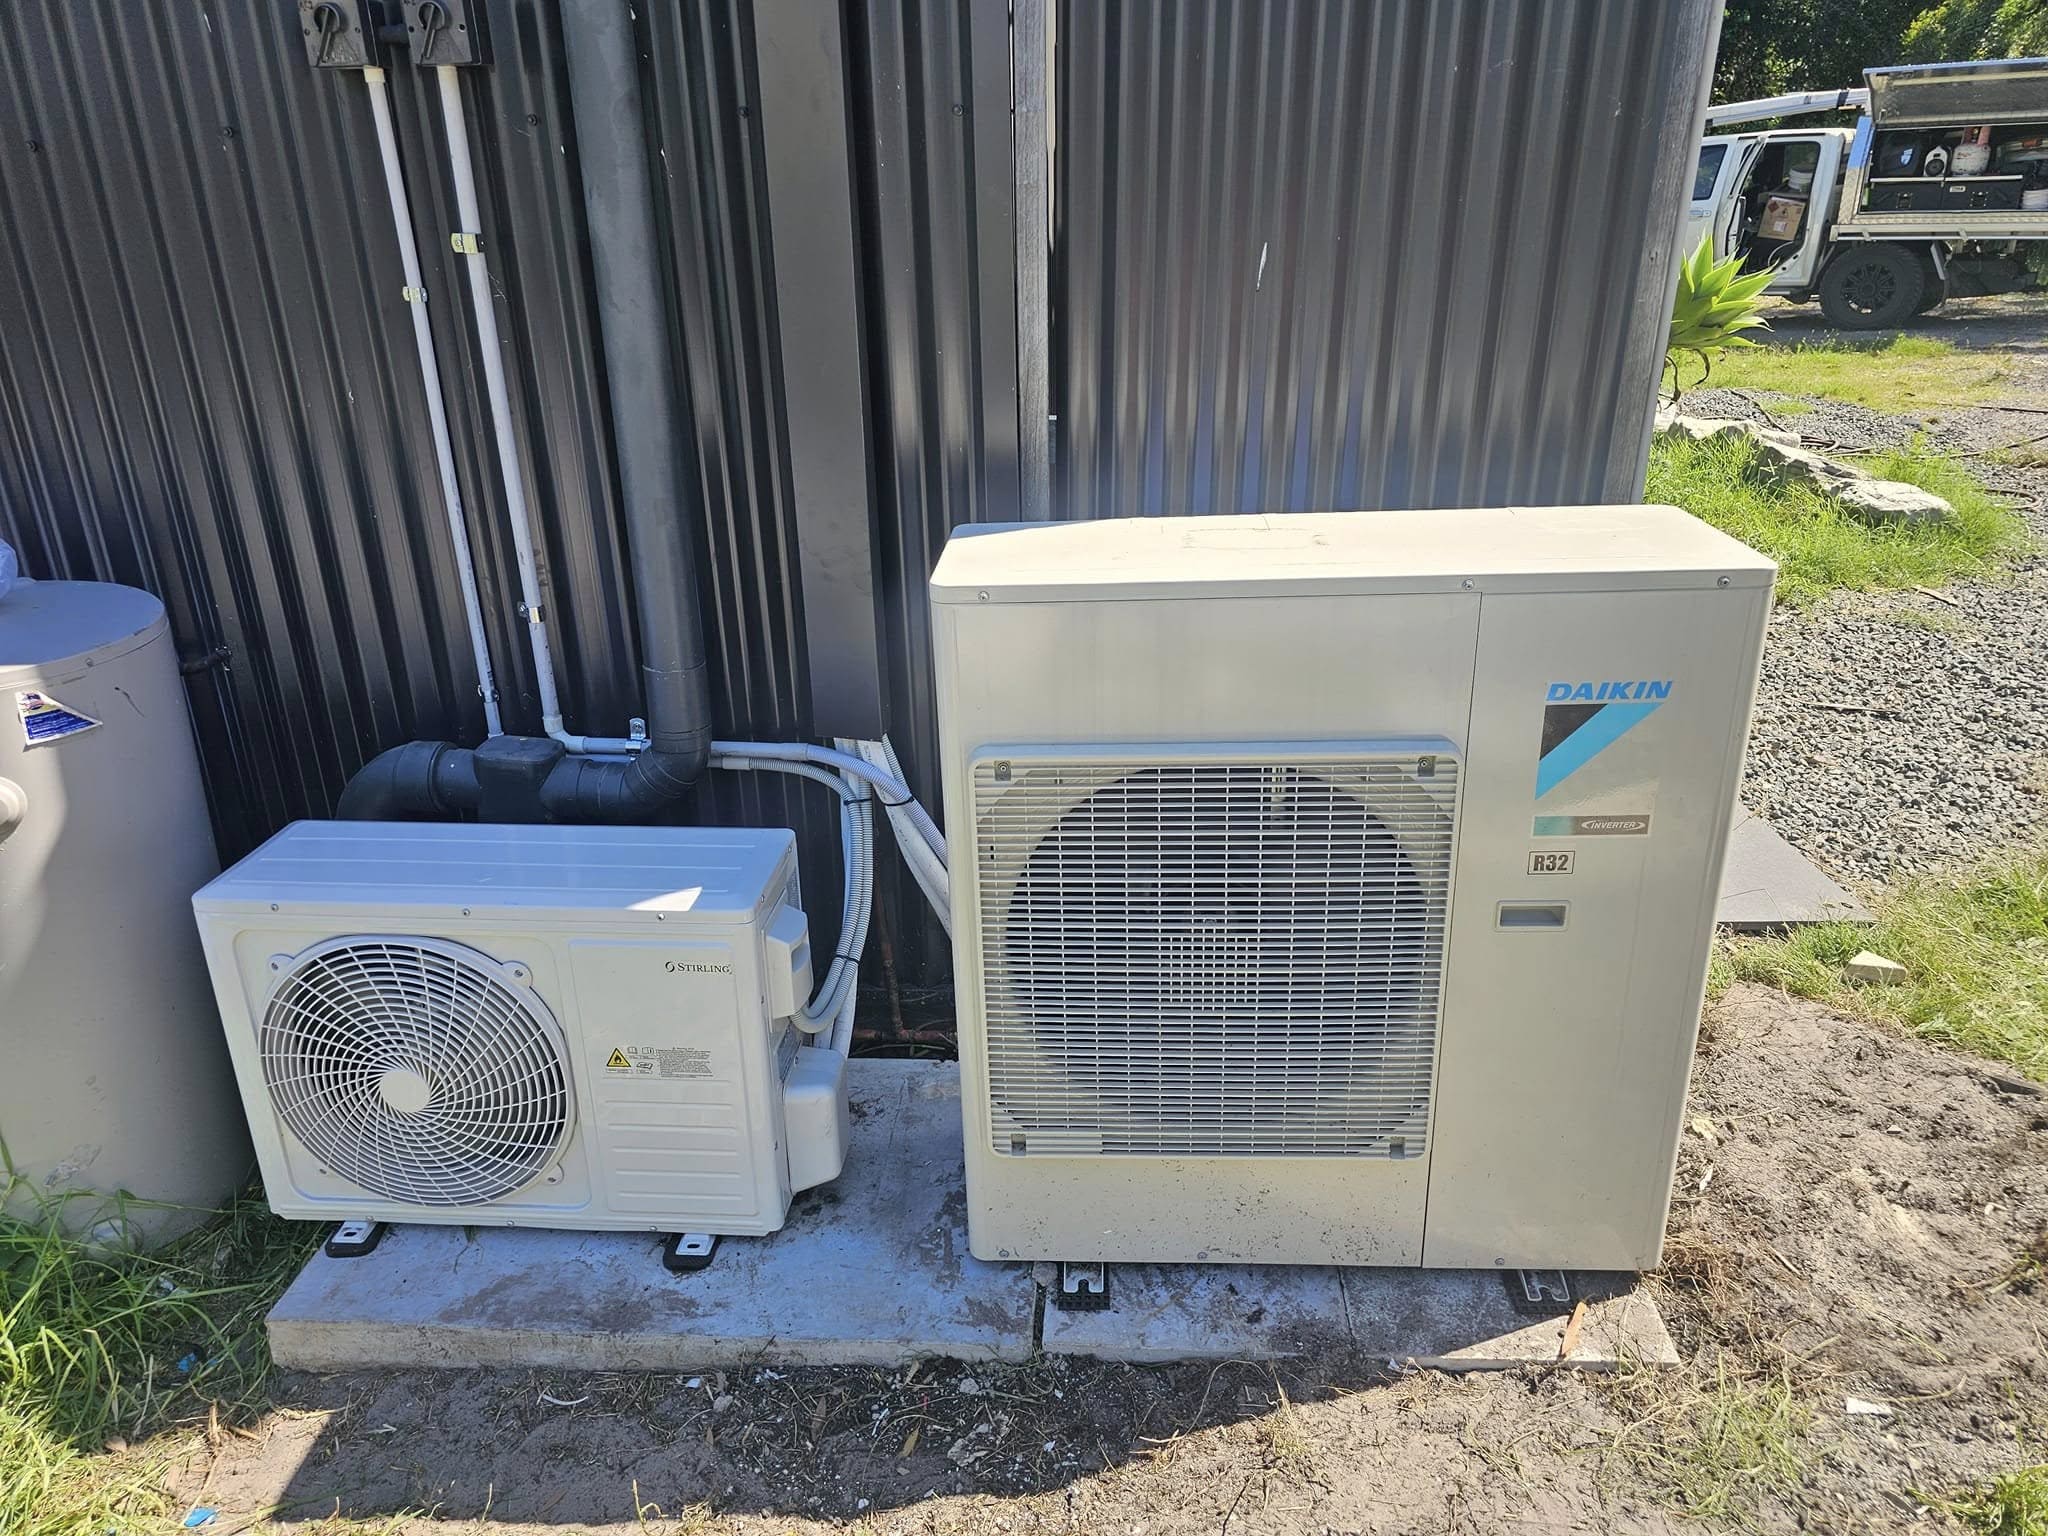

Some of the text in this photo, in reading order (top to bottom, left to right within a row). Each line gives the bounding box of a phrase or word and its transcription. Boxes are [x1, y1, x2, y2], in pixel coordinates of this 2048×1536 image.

[1547, 681, 1672, 700] DAIKIN
[1590, 820, 1636, 830] INVERTER
[1533, 854, 1569, 872] R32
[677, 962, 730, 973] STIRLING
